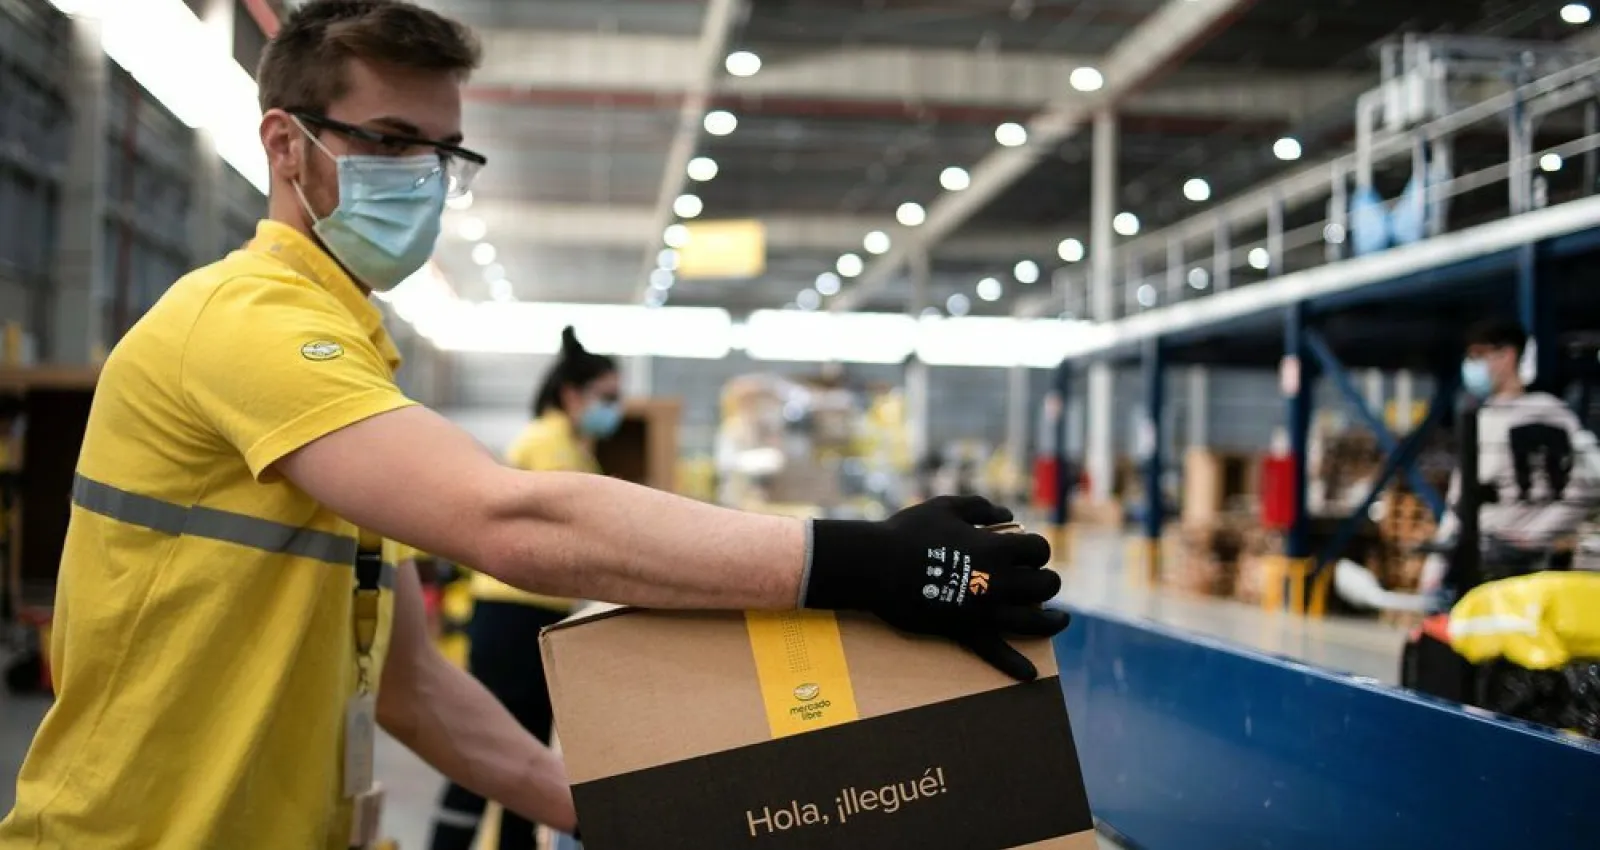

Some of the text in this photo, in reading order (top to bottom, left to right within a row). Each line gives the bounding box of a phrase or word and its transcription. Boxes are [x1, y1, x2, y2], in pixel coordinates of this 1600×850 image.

[790, 699, 831, 716] mercado
[802, 710, 823, 721] libre
[746, 767, 948, 837] Hola, ¡llegué!
